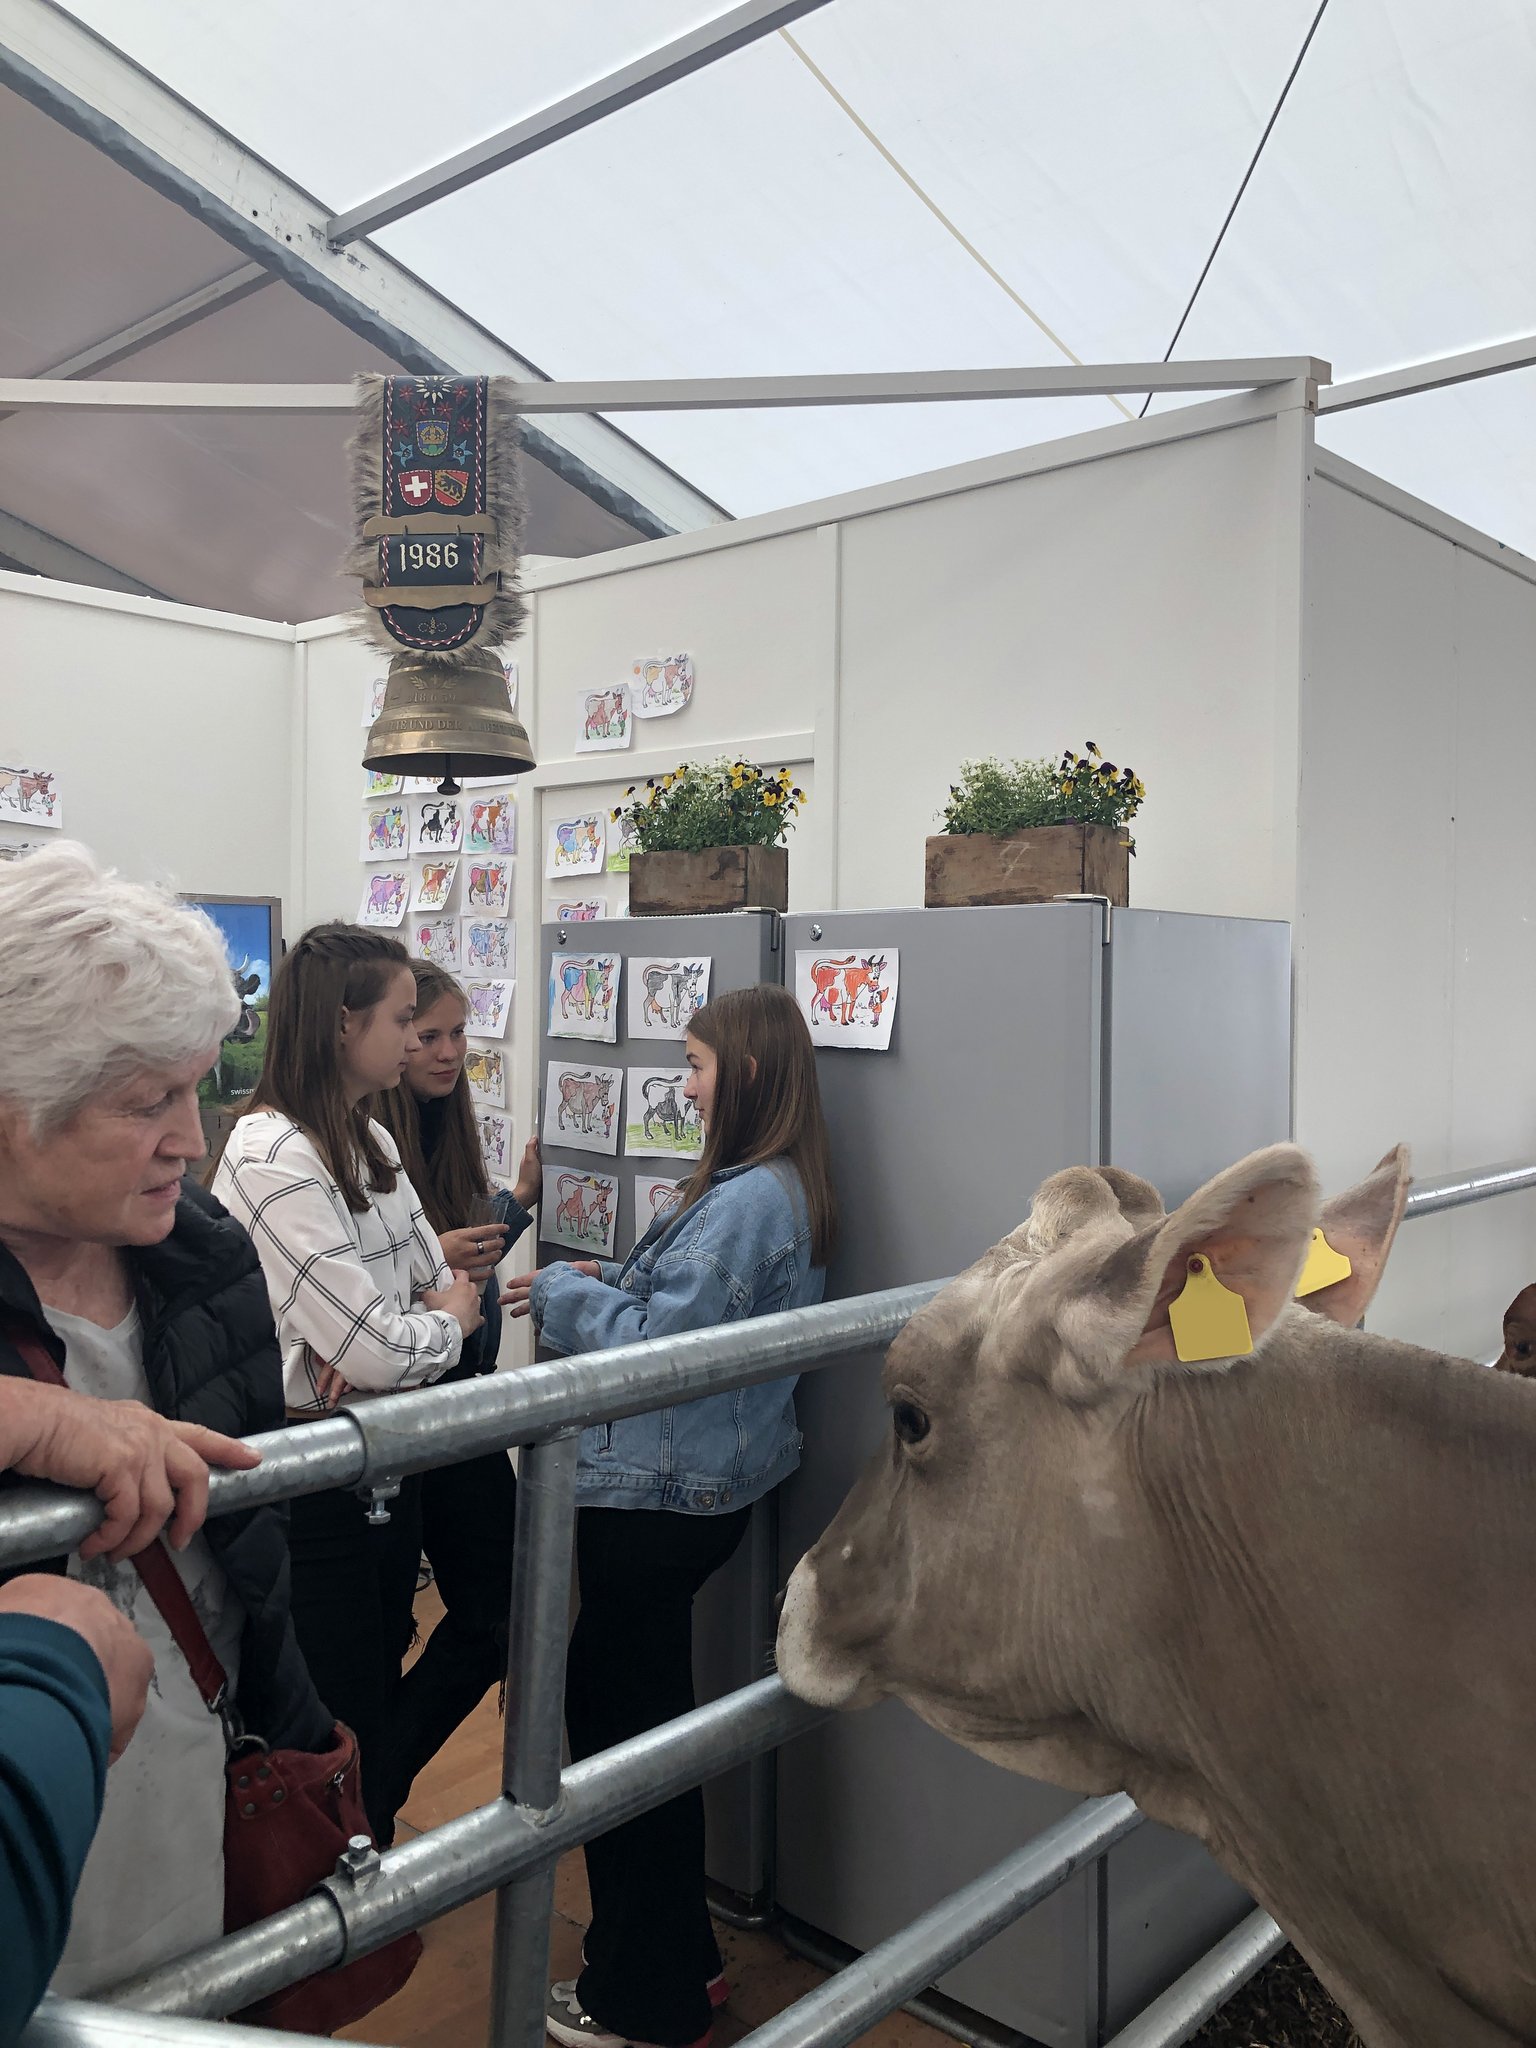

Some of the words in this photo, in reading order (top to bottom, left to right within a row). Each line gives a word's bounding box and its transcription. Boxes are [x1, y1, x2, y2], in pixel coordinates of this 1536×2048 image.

[399, 542, 459, 573] 1986
[409, 719, 434, 730] UND
[437, 719, 463, 730] DER
